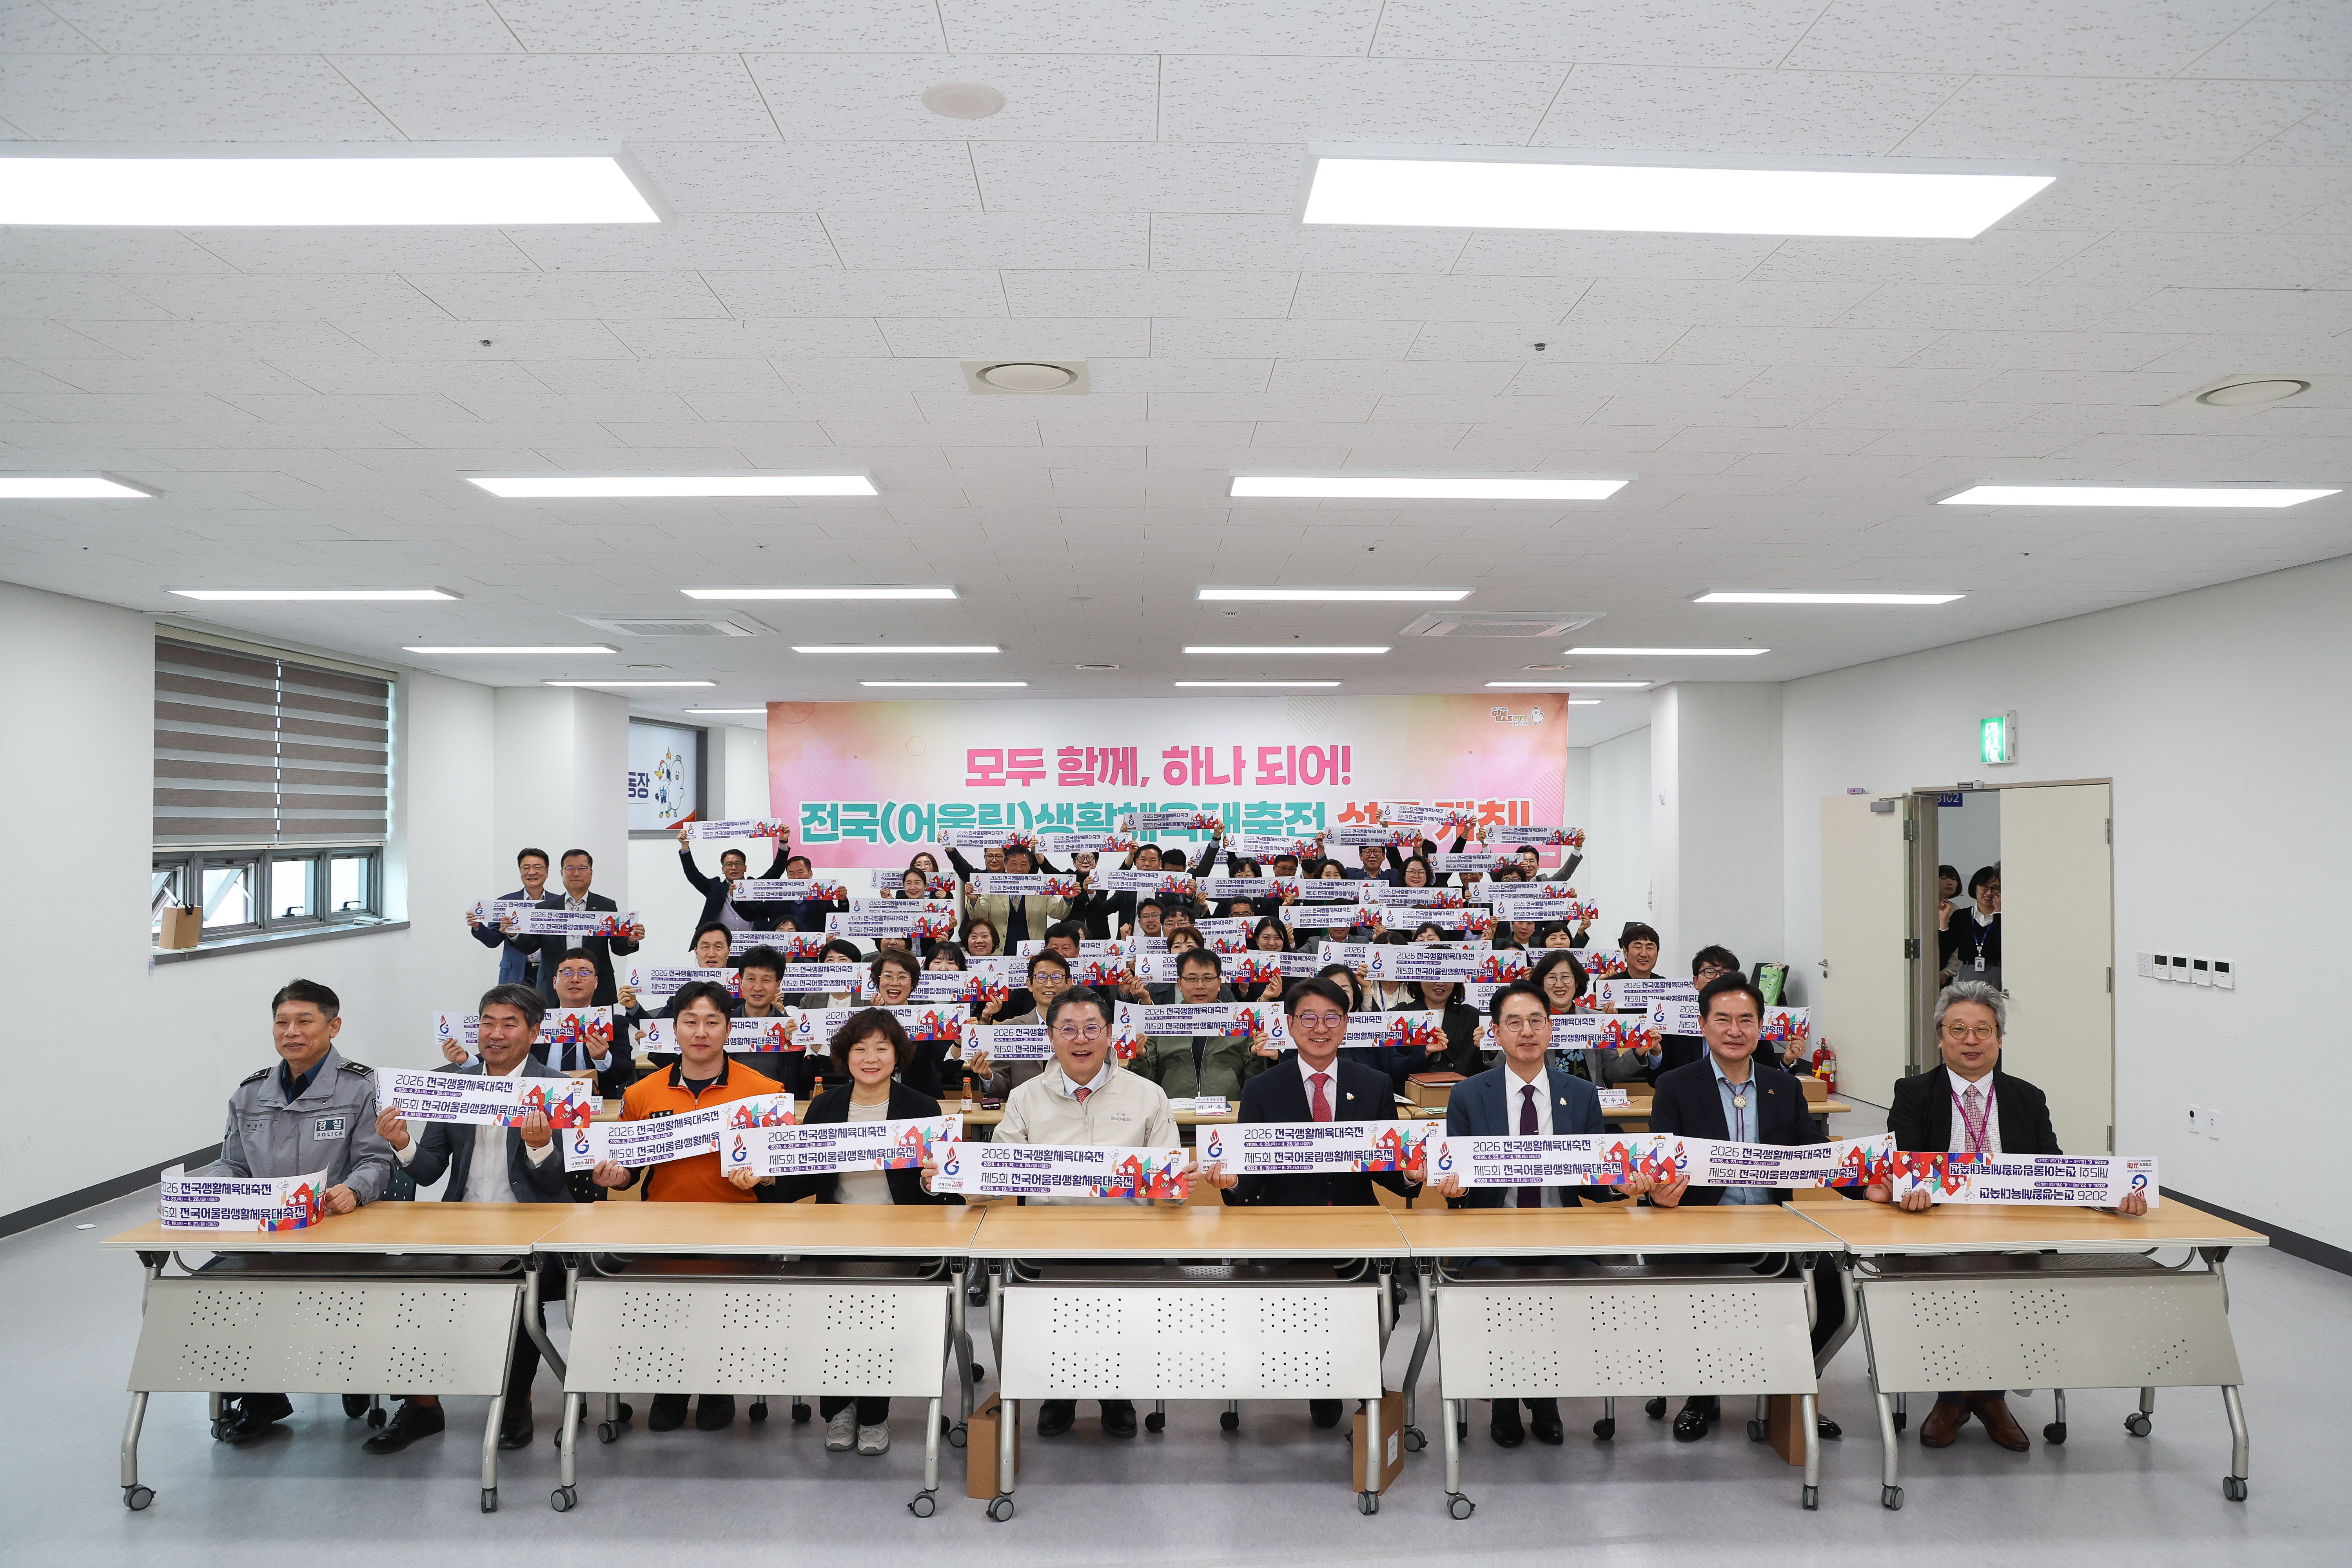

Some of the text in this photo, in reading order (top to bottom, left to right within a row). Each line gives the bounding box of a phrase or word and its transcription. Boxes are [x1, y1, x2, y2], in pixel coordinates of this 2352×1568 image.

[966, 746, 1350, 786] 모두 함께, 하나 되어!
[669, 970, 722, 978] 전국생활체육대축전
[1416, 968, 1493, 977] 전국어울림생활체육대축전
[1166, 1021, 1249, 1029] 전국어울림생활체육대축전
[1679, 1021, 1697, 1029] 제5회
[994, 1045, 1013, 1053] 제5회
[396, 1074, 513, 1093] 2026 전국생활체육대축전
[393, 1097, 537, 1117] 제5회 전국어울림생활체육대축전
[318, 1119, 343, 1131] 경찰
[609, 1111, 719, 1137] 2026 전국생활체육대축전
[769, 1126, 886, 1142] 2026 전국생활체육대축전
[1245, 1127, 1363, 1139] 2026 전국생활체육대축전
[1474, 1140, 1590, 1152] 2026 전국생활체육대축전
[1711, 1145, 1831, 1160] 2026 전국생활체육대축전
[609, 1149, 634, 1159] 제5회
[769, 1146, 916, 1165] 제5회 전국어울림생활체육대축전
[982, 1149, 1104, 1163] 2026 전국생활체육대축전
[1245, 1149, 1394, 1163] 제5회 전국어울림생활체육대축전
[1474, 1161, 1622, 1176] 제5회 전국어울림생활체육대축전
[1709, 1167, 1857, 1180] 제5회 전국어울림생활체육대축전
[1949, 1162, 2108, 1178] 제5회 전국어울림생활체육대축전
[981, 1172, 1133, 1187] 제5회 전국어울림생활체육대축전
[181, 1183, 271, 1195] 전국생활체육대축전
[1980, 1187, 2107, 1201] 2026 전국생활체육대축전
[180, 1205, 306, 1220] 전국어울림생활체육대축전
